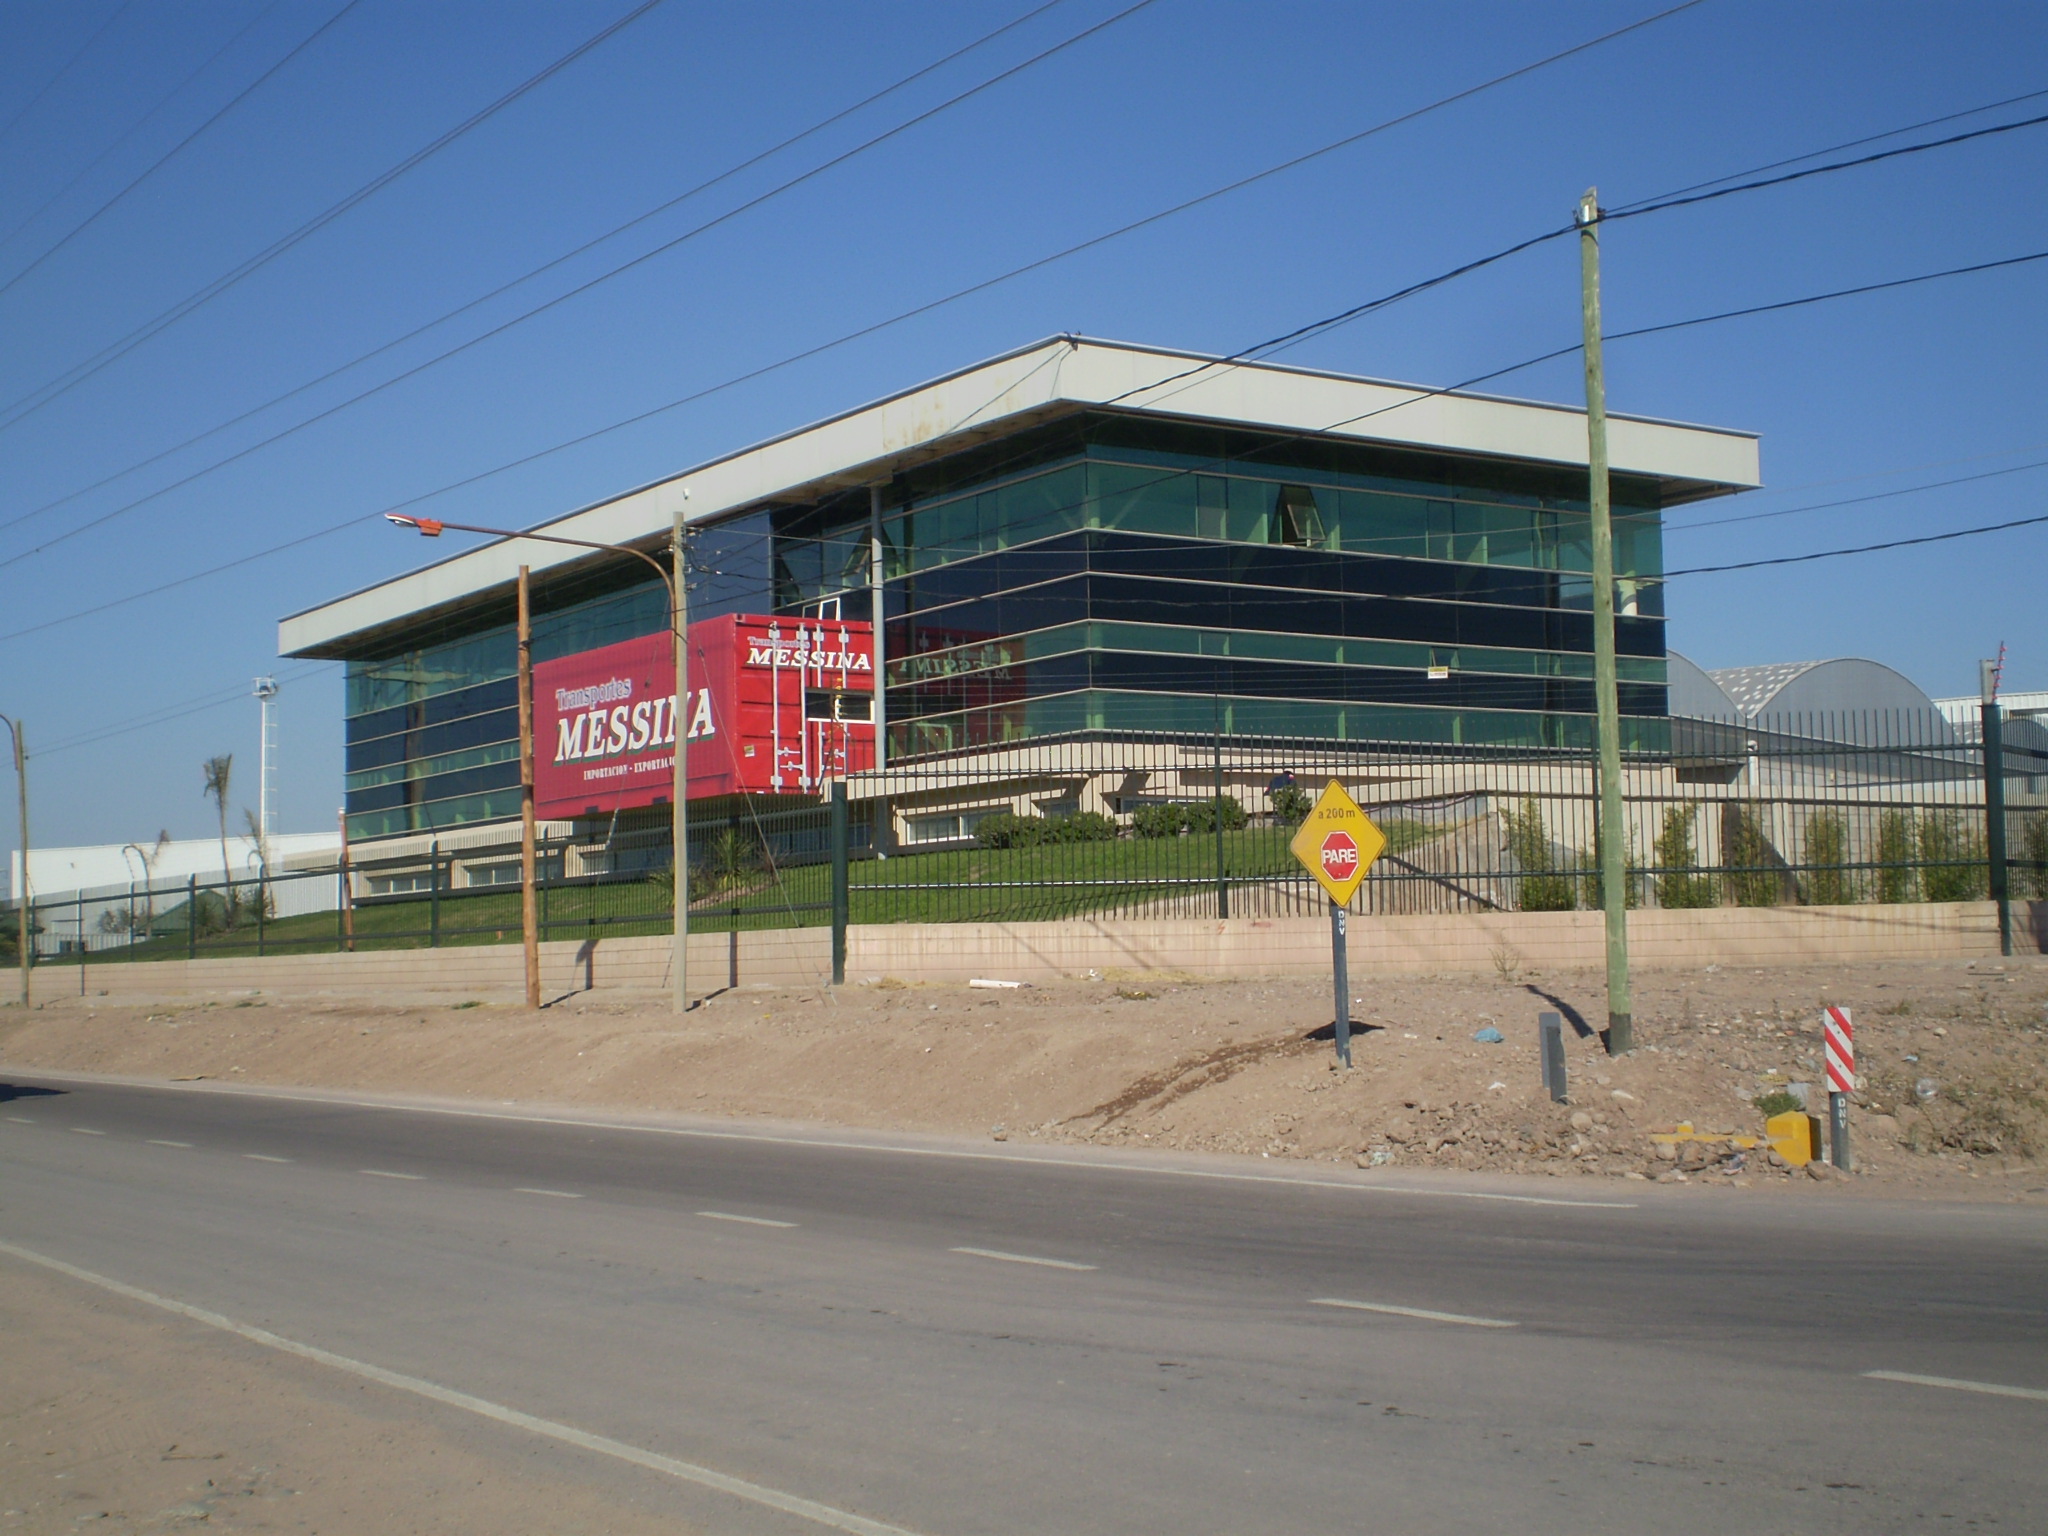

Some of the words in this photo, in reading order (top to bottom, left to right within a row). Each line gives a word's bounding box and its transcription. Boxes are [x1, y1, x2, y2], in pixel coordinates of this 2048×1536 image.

[747, 648, 872, 670] MESSINA
[555, 677, 632, 711] Transportes
[554, 688, 716, 764] MESSINA
[583, 764, 628, 781] IMPORTACION
[634, 755, 676, 774] EXPORTACIO
[1318, 810, 1324, 819] a
[1326, 808, 1344, 819] 200
[1346, 809, 1355, 818] m
[1322, 848, 1357, 864] PARE
